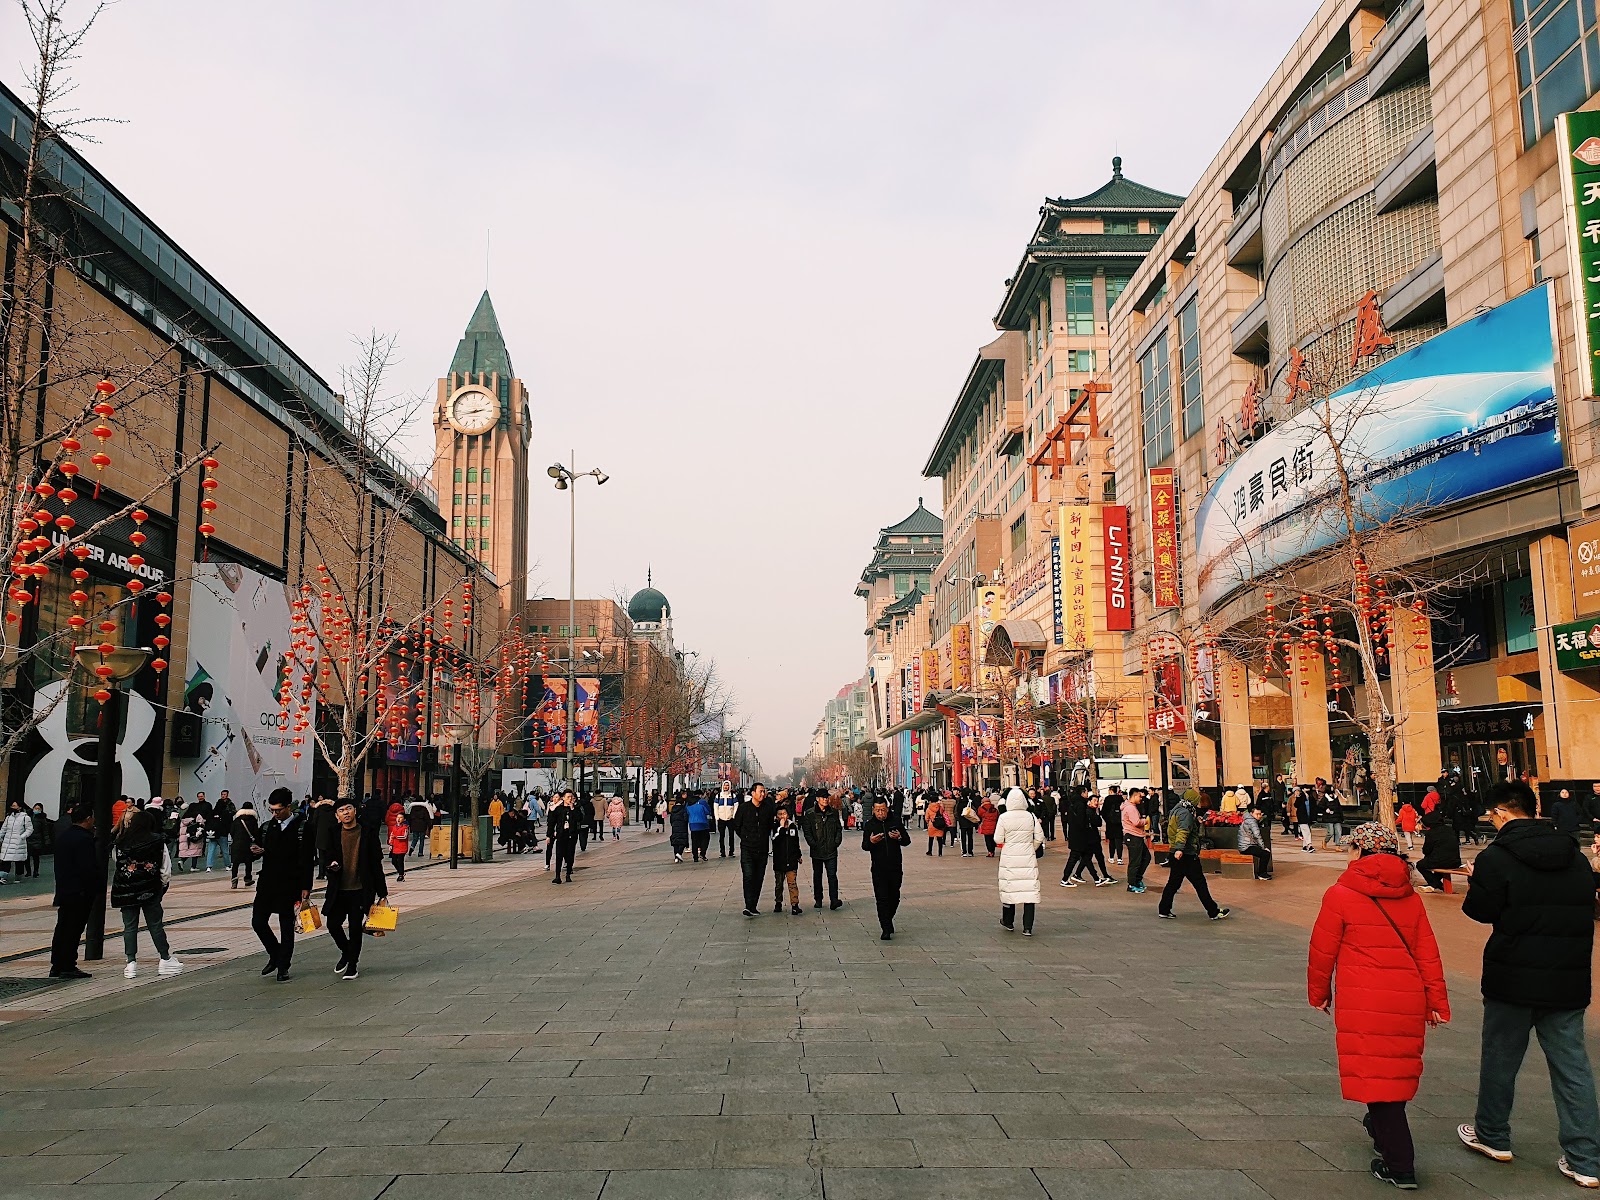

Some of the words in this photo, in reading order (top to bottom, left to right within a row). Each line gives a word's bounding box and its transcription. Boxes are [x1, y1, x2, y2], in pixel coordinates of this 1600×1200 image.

[51, 530, 105, 562] UNER
[1108, 526, 1125, 609] LI-NING
[1069, 511, 1086, 643] 新中国儿童用品商店
[1556, 630, 1588, 651] 天福
